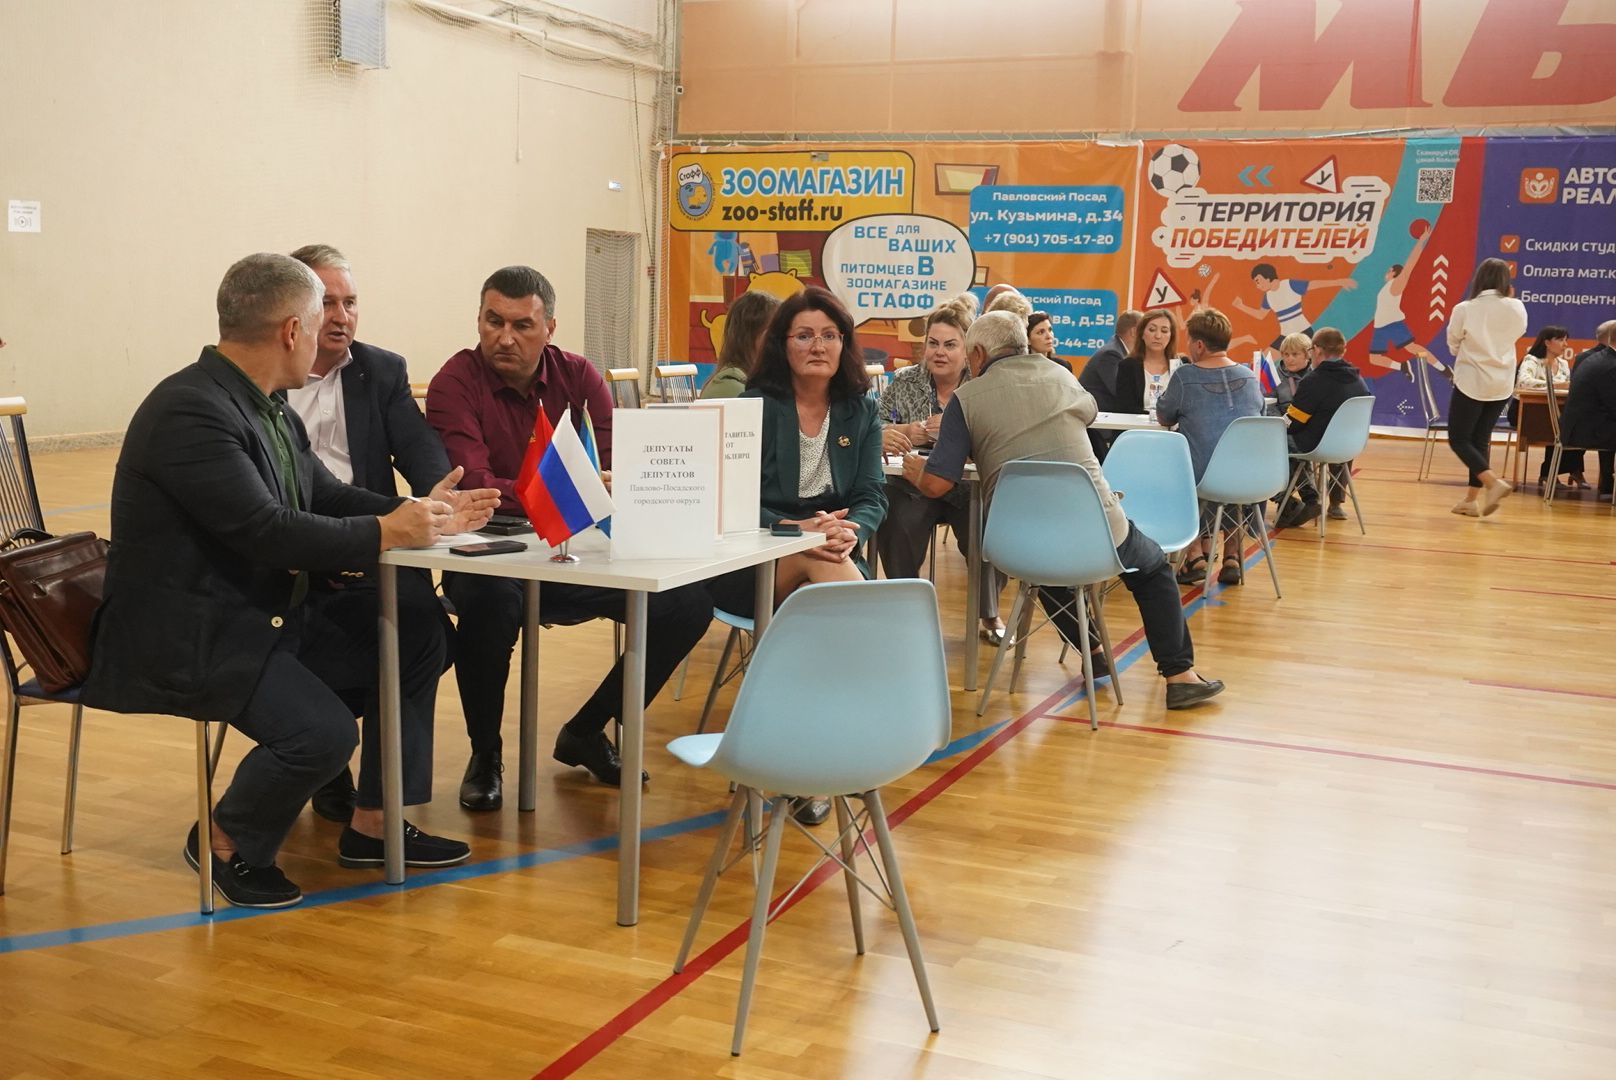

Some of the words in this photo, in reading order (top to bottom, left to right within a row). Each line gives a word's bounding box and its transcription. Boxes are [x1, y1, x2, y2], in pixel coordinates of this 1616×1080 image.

[721, 167, 904, 196] ЗООМАГАЗИН
[993, 192, 1066, 202] Павловский
[1069, 193, 1107, 203] Посад
[722, 199, 843, 221] zoo-staff.ru
[1198, 201, 1376, 223] ТЕРРИТОРИЯ
[970, 211, 993, 224] ул.
[998, 210, 1082, 225] Кузьмина,
[1086, 210, 1123, 224] д.34
[854, 226, 888, 239] ВСЕ
[1170, 223, 1370, 252] ПОБЕДИТЕЛЕЙ
[888, 239, 956, 253] ВАШИХ
[984, 234, 1001, 244] +7
[1003, 233, 1040, 246] (901)
[1043, 234, 1114, 245] 705-17-20
[1525, 238, 1579, 253] Скидки
[840, 263, 914, 276] ПИТОМЦЕВ
[917, 255, 935, 276] В
[1523, 264, 1575, 277] Оплата
[846, 278, 947, 291] ЗООМАГАЗИНЕ
[857, 292, 934, 310] СТАФФ
[1063, 296, 1102, 306] Посад
[1521, 290, 1616, 306] Беспроцентн
[1079, 314, 1115, 327] д.52
[642, 445, 693, 453] ДЕПУТАТЫ
[640, 471, 695, 479] ДЕПУТАТОВ
[630, 484, 705, 492] Павлово-Посадского
